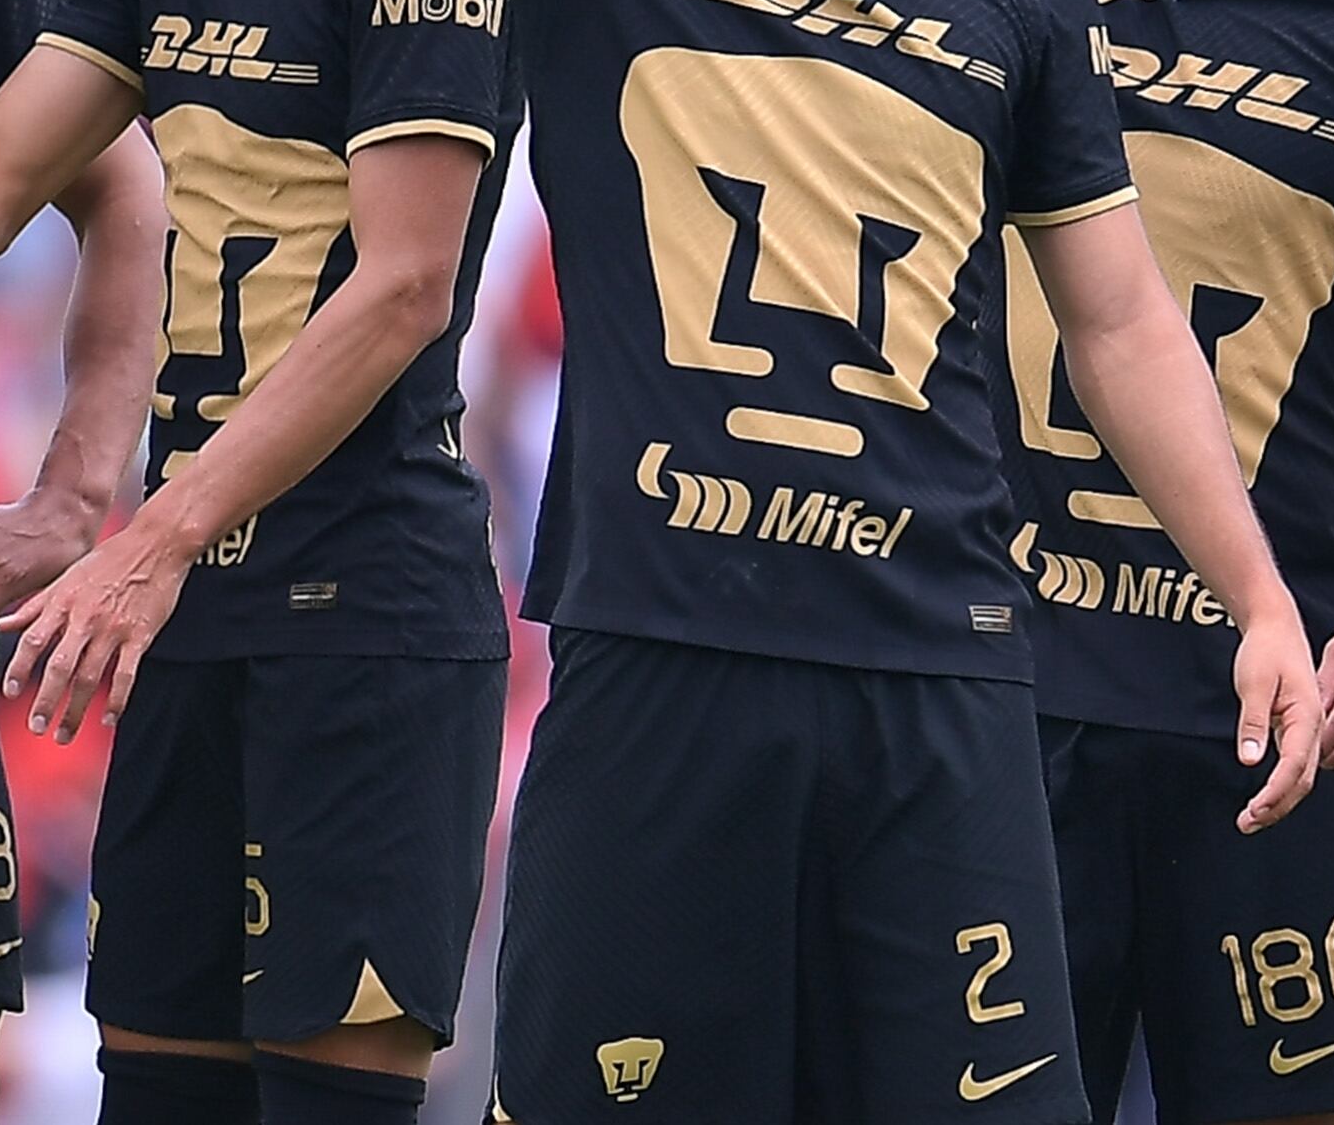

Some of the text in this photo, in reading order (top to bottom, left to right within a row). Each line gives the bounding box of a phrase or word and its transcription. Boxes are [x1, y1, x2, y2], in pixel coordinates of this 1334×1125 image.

[143, 14, 277, 81] DHL
[1108, 44, 1321, 132] DHL
[757, 487, 914, 559] Mifel
[1112, 563, 1236, 627] Mife
[956, 922, 1025, 1023] 2
